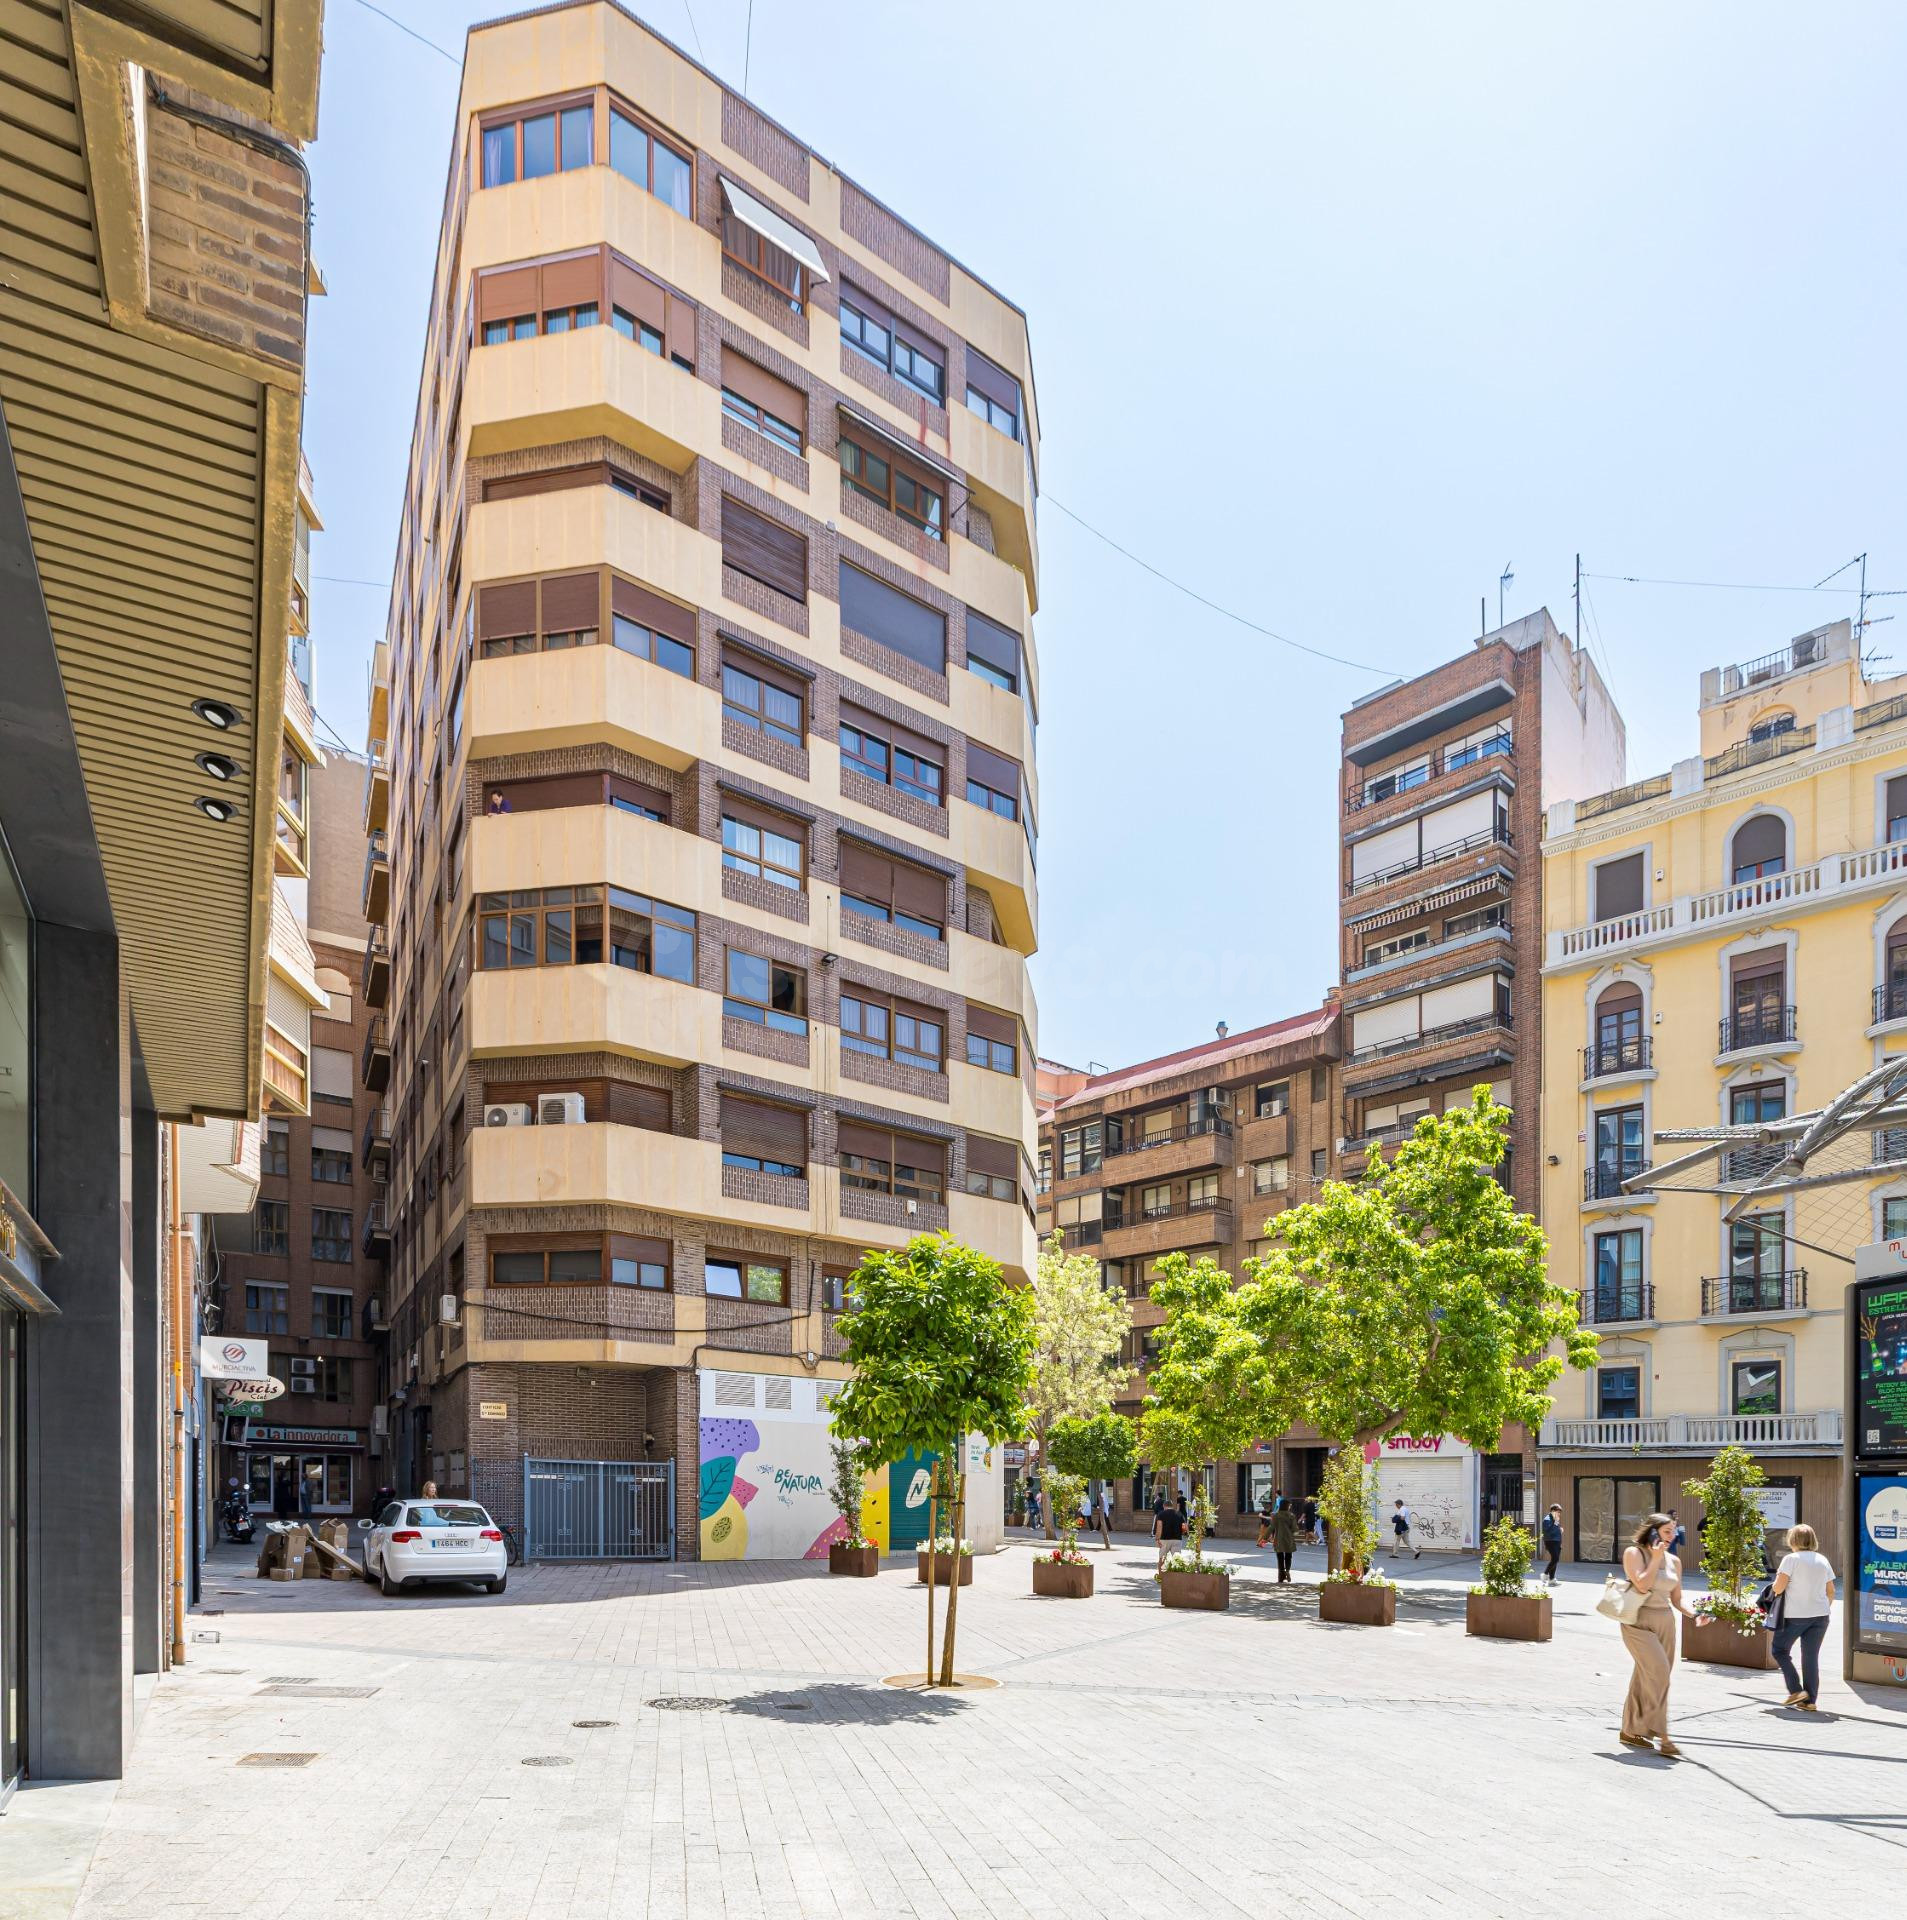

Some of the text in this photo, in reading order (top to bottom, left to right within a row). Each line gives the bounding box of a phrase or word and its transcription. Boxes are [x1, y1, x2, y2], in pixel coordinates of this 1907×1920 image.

[224, 1379, 278, 1396] Piscis
[267, 1428, 349, 1441] La innovadora
[1388, 1436, 1443, 1453] smooy
[780, 1473, 823, 1494] NATURA
